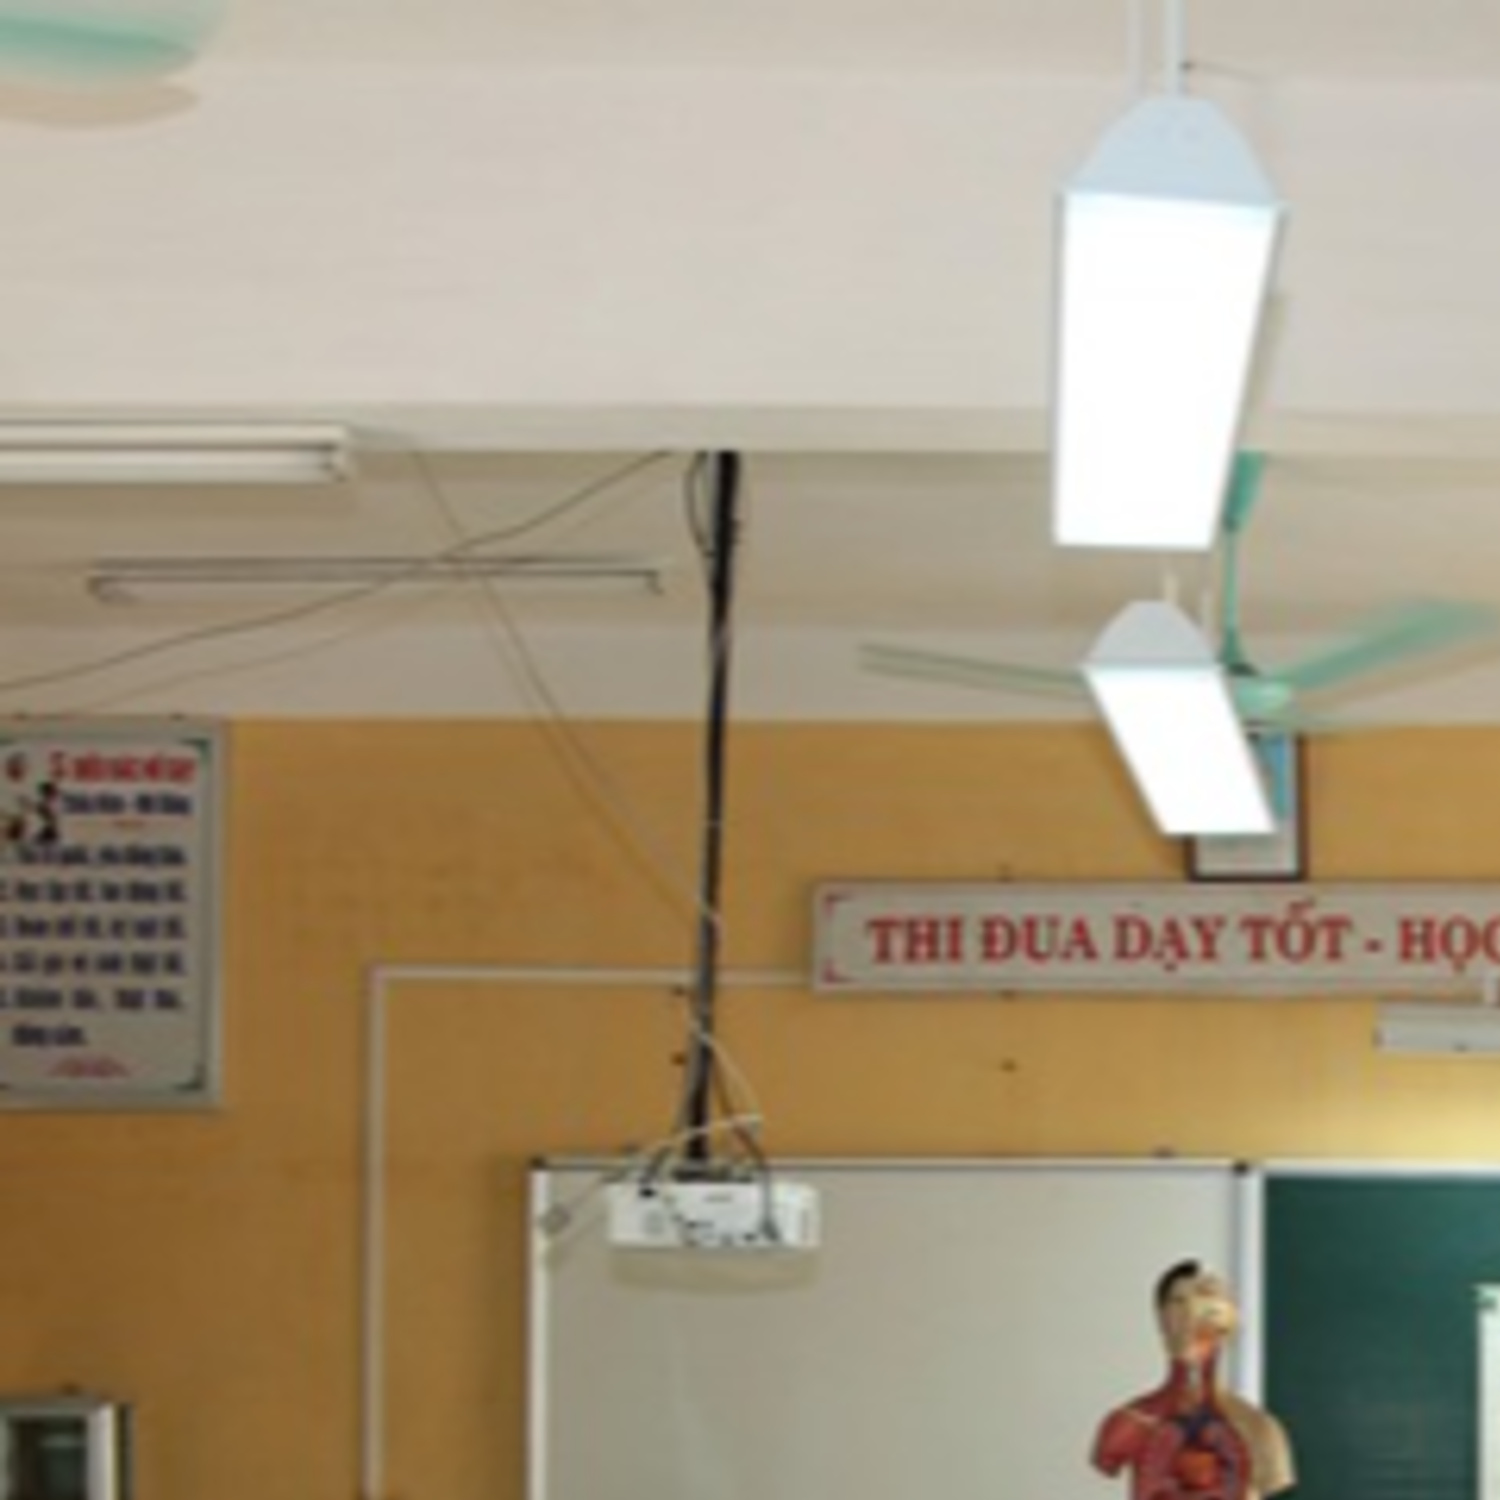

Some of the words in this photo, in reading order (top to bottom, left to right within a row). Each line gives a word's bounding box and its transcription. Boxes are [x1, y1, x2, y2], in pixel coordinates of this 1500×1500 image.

[867, 914, 963, 964] THI
[1113, 914, 1226, 972] DẠY
[1240, 899, 1352, 964] TỐT
